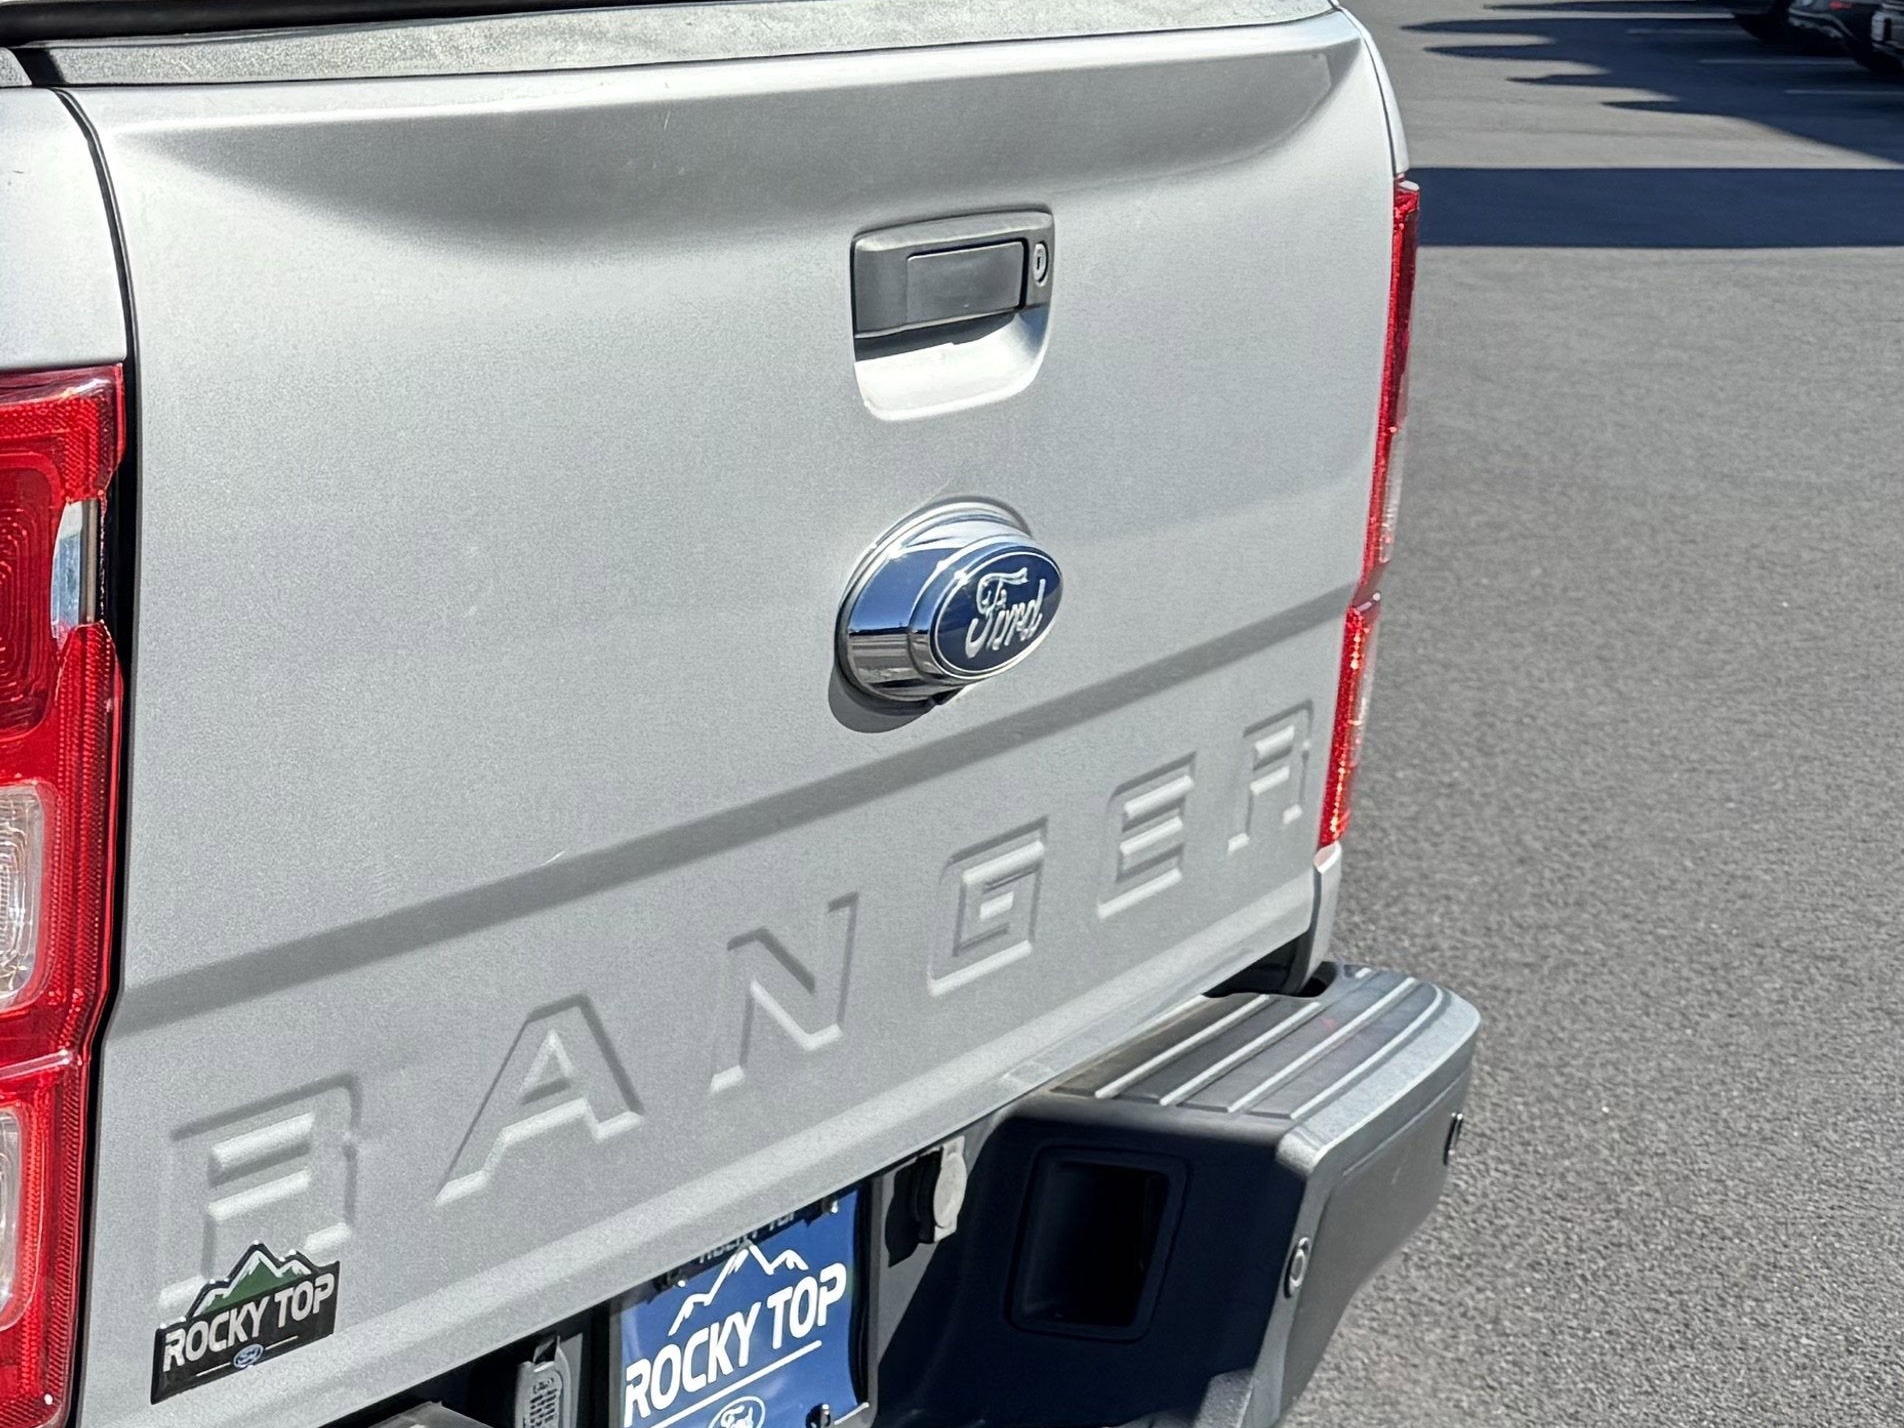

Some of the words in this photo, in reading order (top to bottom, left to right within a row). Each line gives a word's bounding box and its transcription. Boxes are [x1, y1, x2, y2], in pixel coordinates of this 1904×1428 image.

[965, 567, 1046, 659] Ford
[156, 696, 1314, 1310] RANGER
[162, 1296, 270, 1372] ROCKY
[274, 1273, 335, 1329] TOP
[623, 1302, 762, 1428] ROCKY
[767, 1262, 847, 1350] TOP
